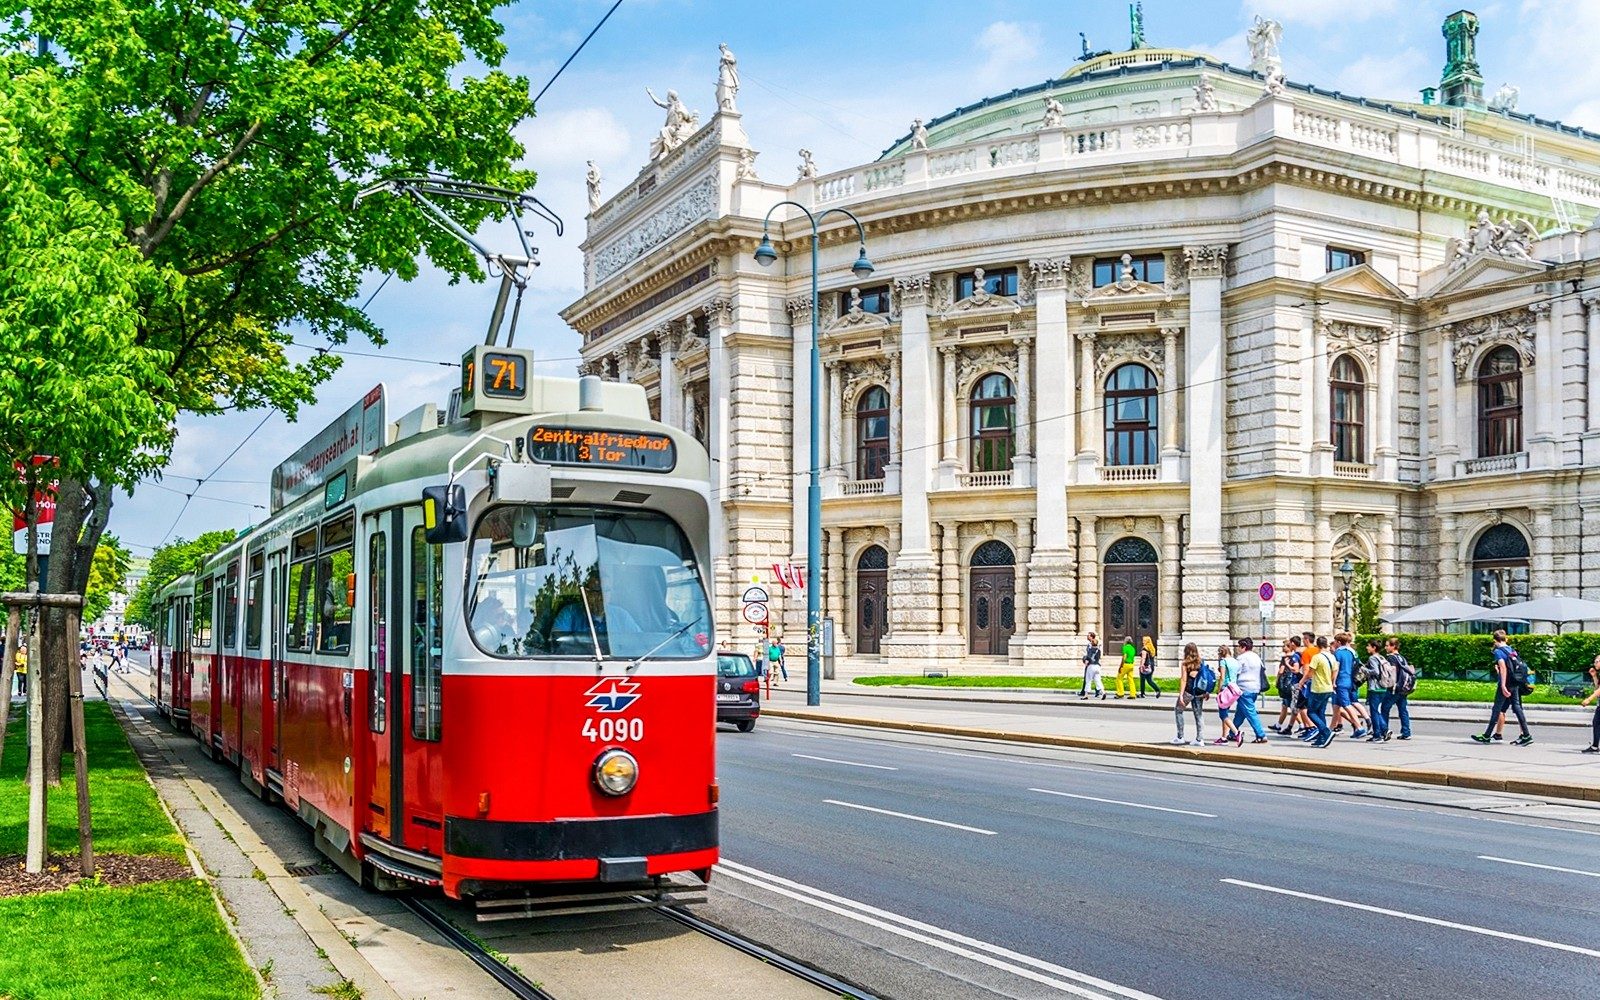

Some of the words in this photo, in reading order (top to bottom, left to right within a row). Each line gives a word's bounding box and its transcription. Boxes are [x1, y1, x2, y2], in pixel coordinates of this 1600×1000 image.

[491, 359, 516, 390] 71
[533, 428, 671, 451] Zentralfriedhof
[597, 447, 626, 462] Tor
[581, 718, 644, 742] 4090
